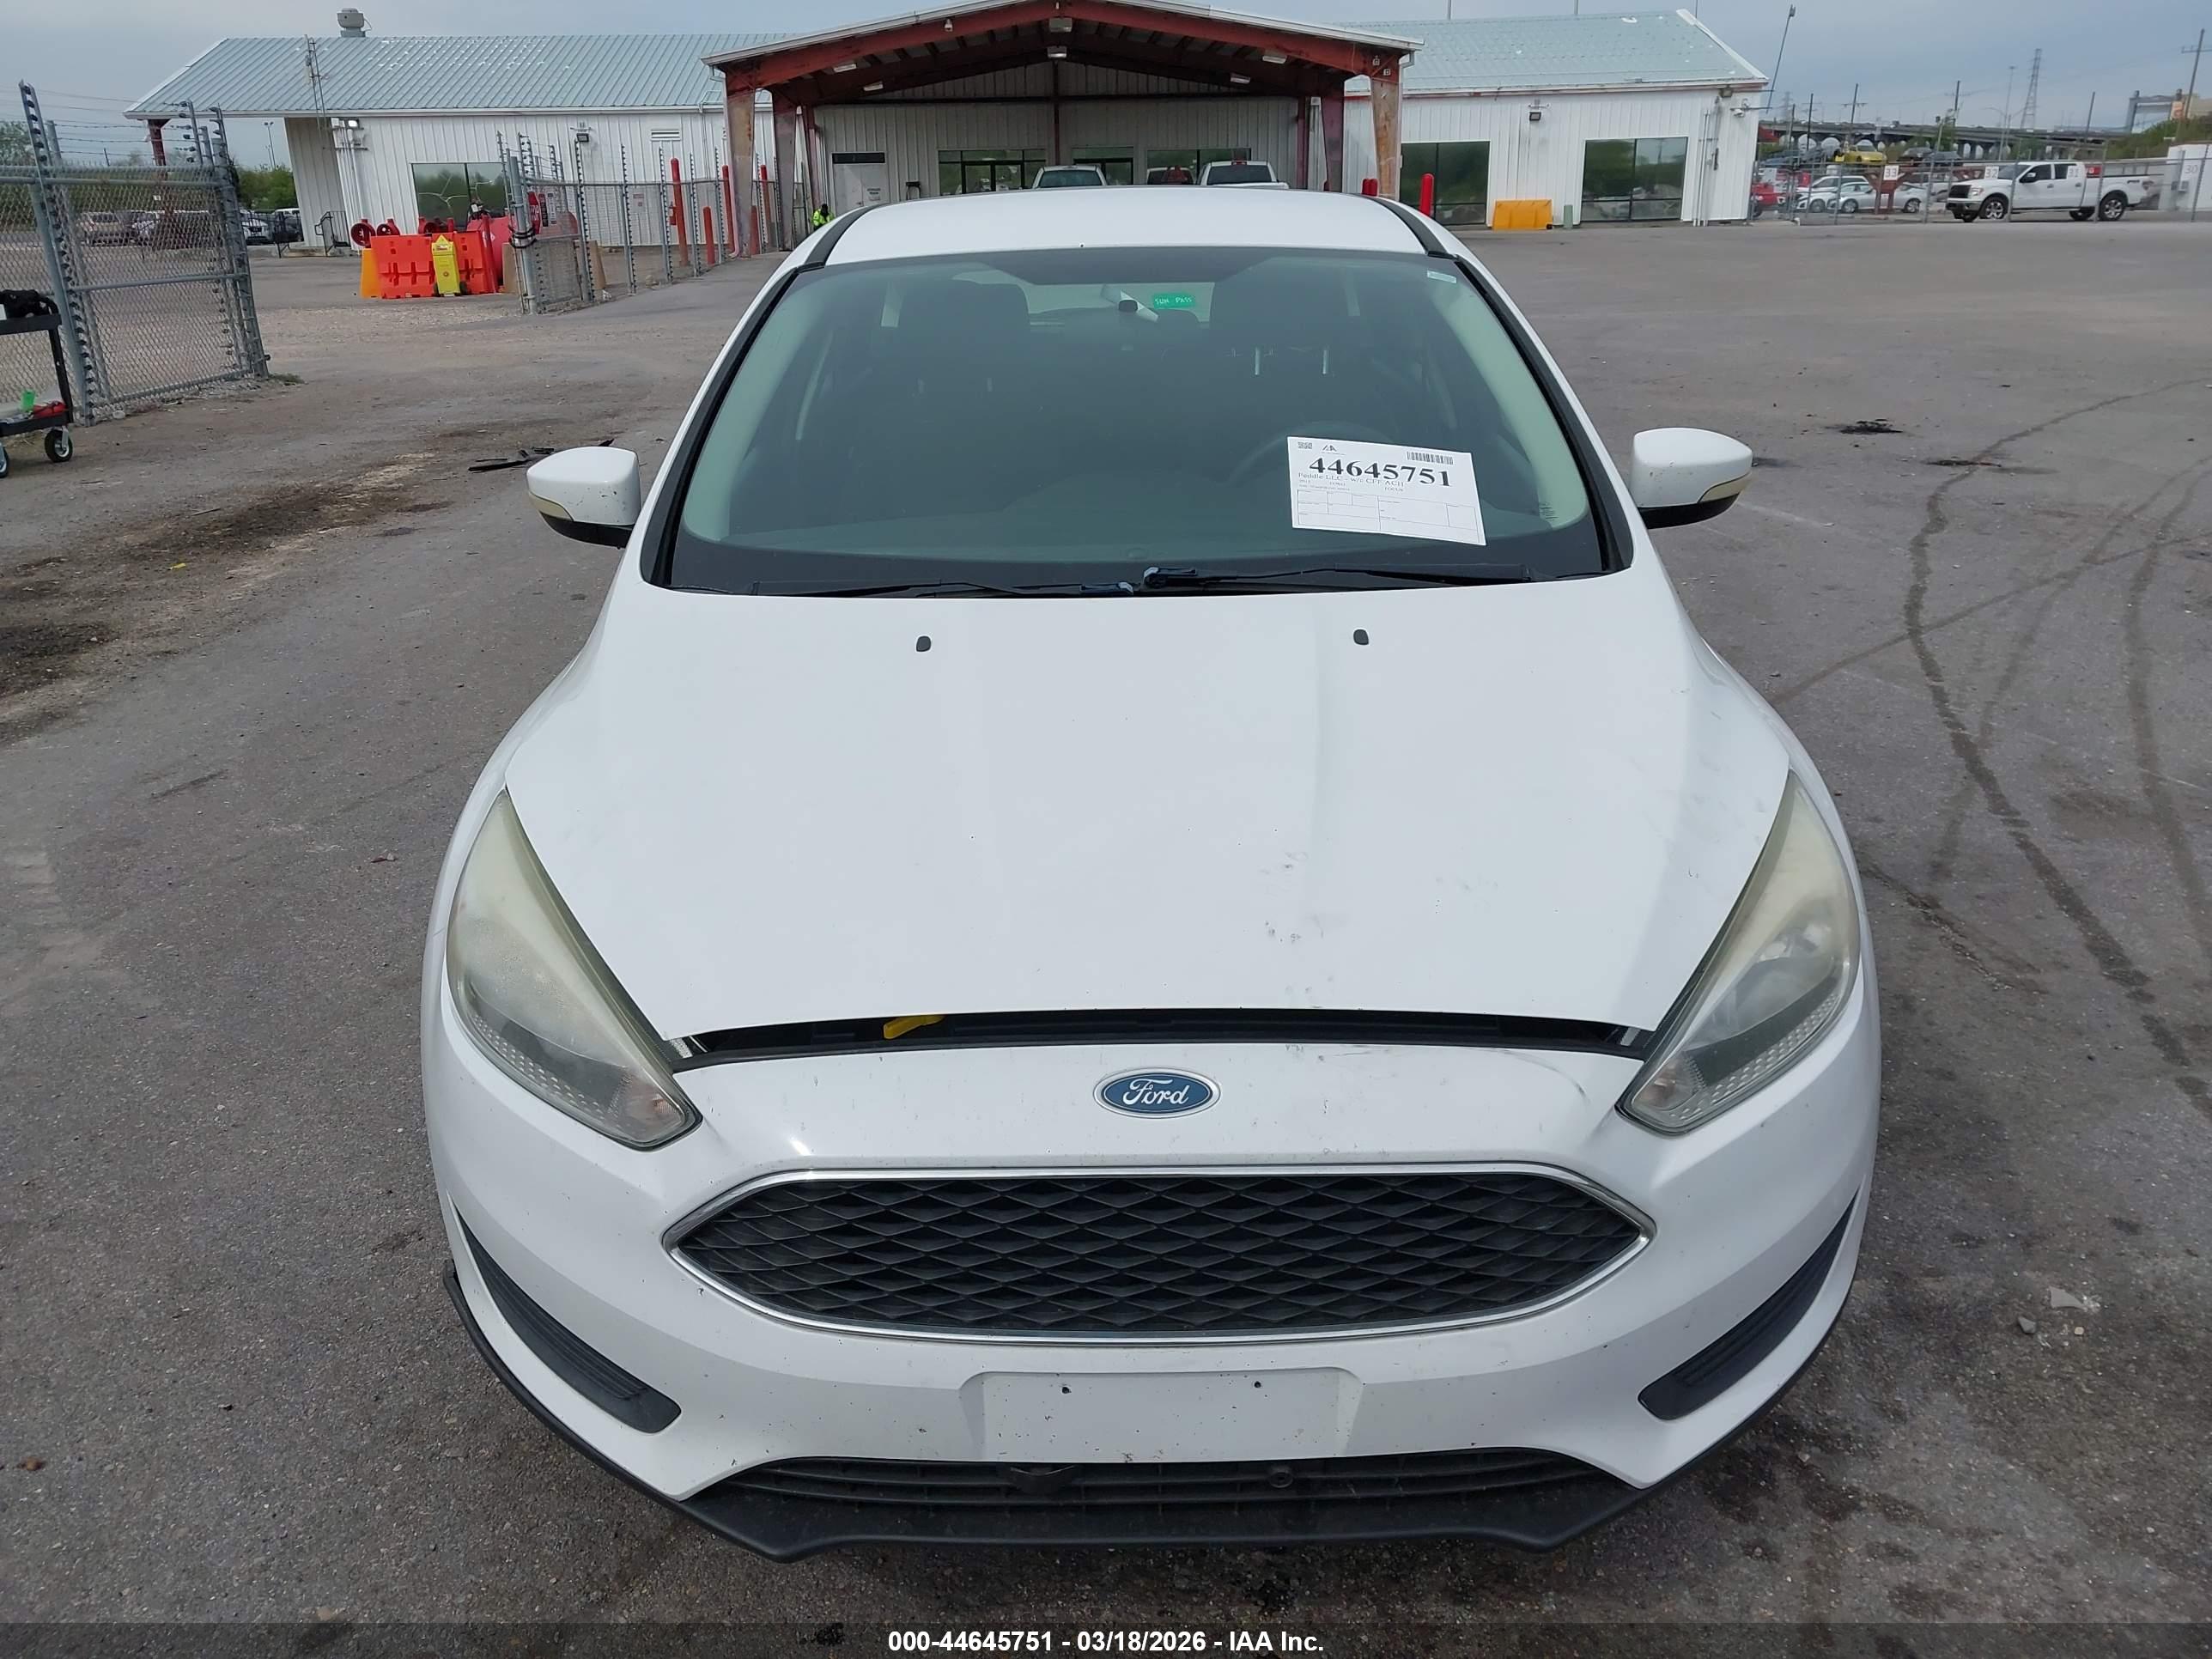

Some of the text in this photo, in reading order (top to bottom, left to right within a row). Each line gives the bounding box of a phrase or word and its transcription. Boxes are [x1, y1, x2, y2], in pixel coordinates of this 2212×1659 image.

[1885, 167, 1897, 178] 33
[1985, 168, 1997, 179] 32
[1309, 457, 1453, 487] 44645751
[1122, 1078, 1190, 1105] Ford
